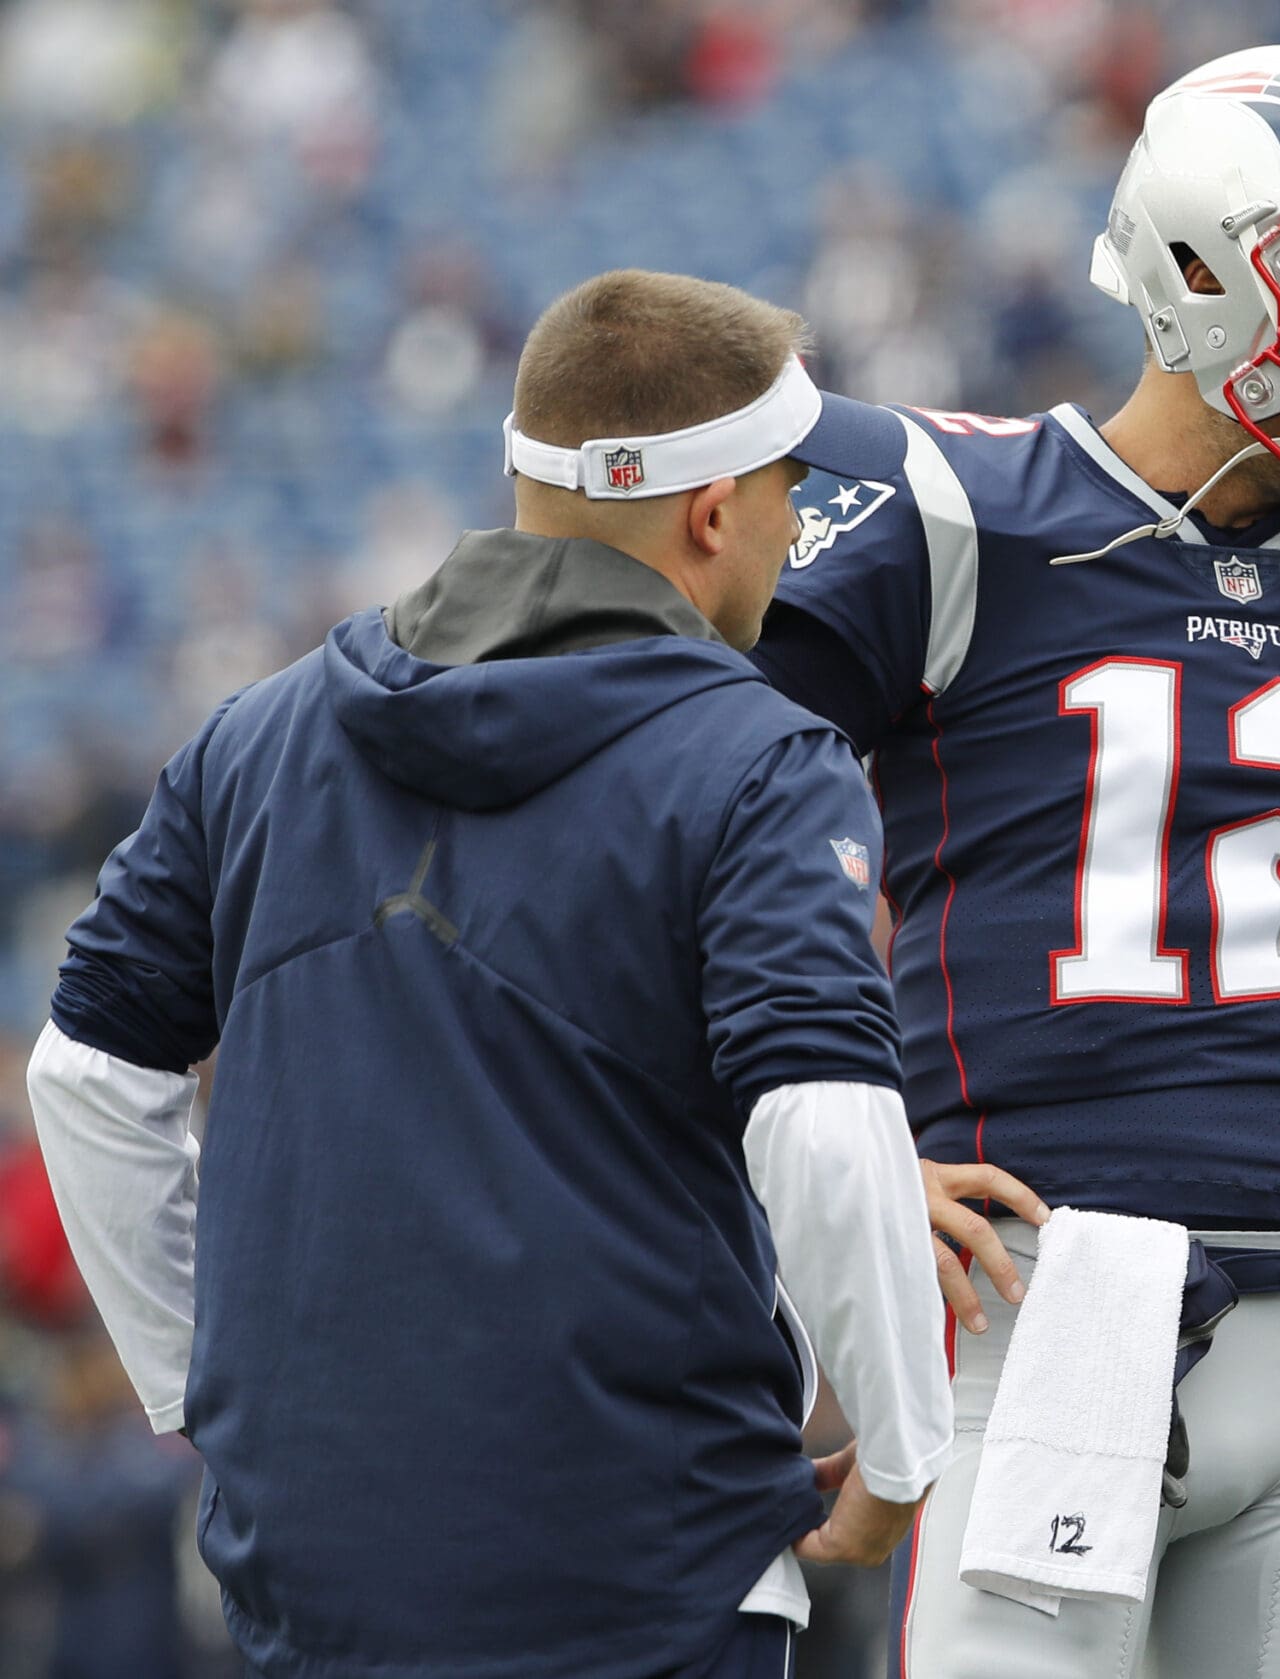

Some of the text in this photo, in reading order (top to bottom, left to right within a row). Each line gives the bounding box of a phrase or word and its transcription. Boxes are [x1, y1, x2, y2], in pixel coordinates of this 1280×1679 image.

[610, 466, 642, 488] NFL
[1225, 577, 1256, 596] NFL
[1048, 1511, 1094, 1558] 12
